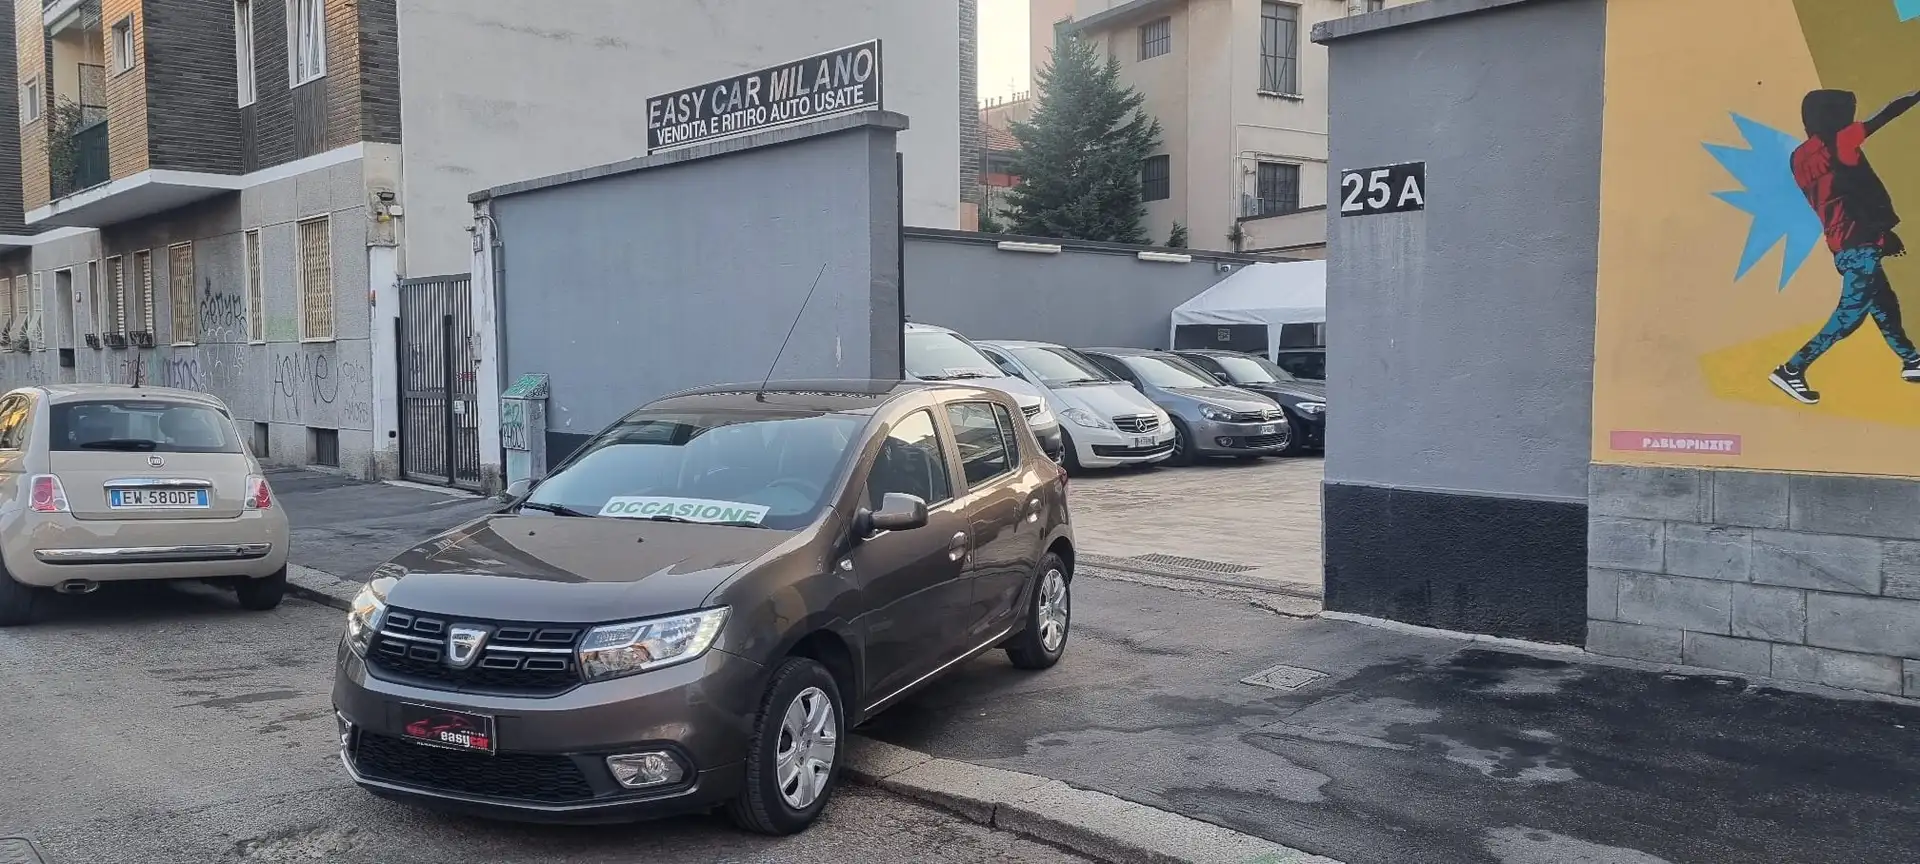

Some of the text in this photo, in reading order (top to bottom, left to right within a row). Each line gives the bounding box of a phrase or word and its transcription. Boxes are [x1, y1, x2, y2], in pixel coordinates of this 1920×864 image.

[649, 48, 873, 129] EASY CAR MILANO
[656, 84, 865, 146] VENDITA E RITIRO AUTO USATE
[1341, 168, 1424, 212] 25 A
[1642, 437, 1734, 451] PABLOPINXIT
[123, 491, 197, 505] EW 580DF
[606, 501, 761, 523] OCCASIONE
